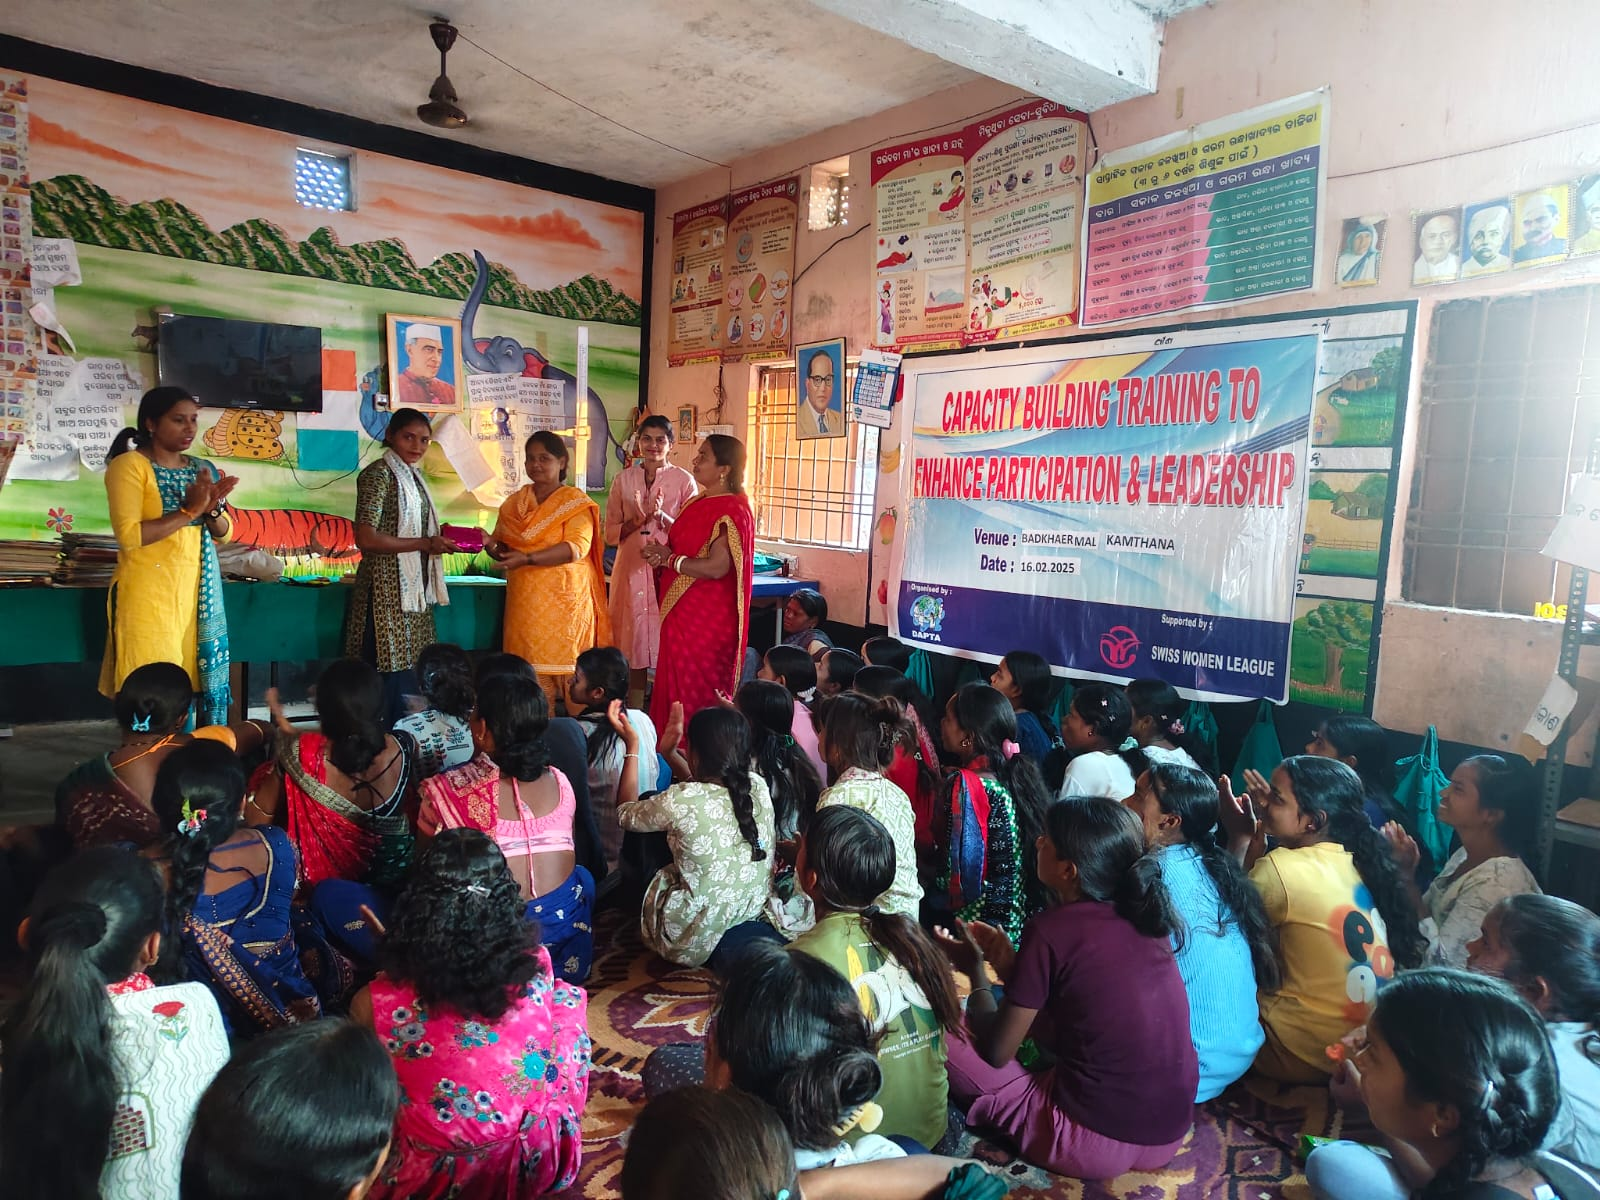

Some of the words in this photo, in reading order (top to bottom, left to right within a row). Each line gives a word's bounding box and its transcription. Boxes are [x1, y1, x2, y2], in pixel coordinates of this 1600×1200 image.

[1192, 146, 1198, 156] ଓ
[1131, 194, 1159, 208] ସକାଳ
[1205, 178, 1214, 188] ଓ
[1219, 171, 1247, 186] ଗରମ
[942, 386, 1020, 432] CAPACITY
[1022, 379, 1110, 430] BUILDING
[1116, 370, 1222, 426] TRAINING
[1228, 366, 1260, 422] TO
[914, 456, 985, 499] ENHANCE
[986, 455, 1122, 504] PARTICIPATION
[1127, 454, 1141, 503] &
[1148, 452, 1296, 507] LEADERSHIP
[974, 528, 1009, 546] Venue
[1106, 534, 1175, 551] KAMTHANA
[980, 554, 1007, 572] Date
[1021, 562, 1075, 573] 16.02.2025
[911, 584, 940, 594] Organised
[941, 587, 948, 595] by
[1161, 614, 1196, 628] Supported
[1198, 618, 1207, 631] by
[912, 630, 941, 641] DAPTA
[1151, 645, 1180, 664] SWISS
[1182, 650, 1223, 670] WOMEN
[1226, 656, 1275, 677] LEAGUE
